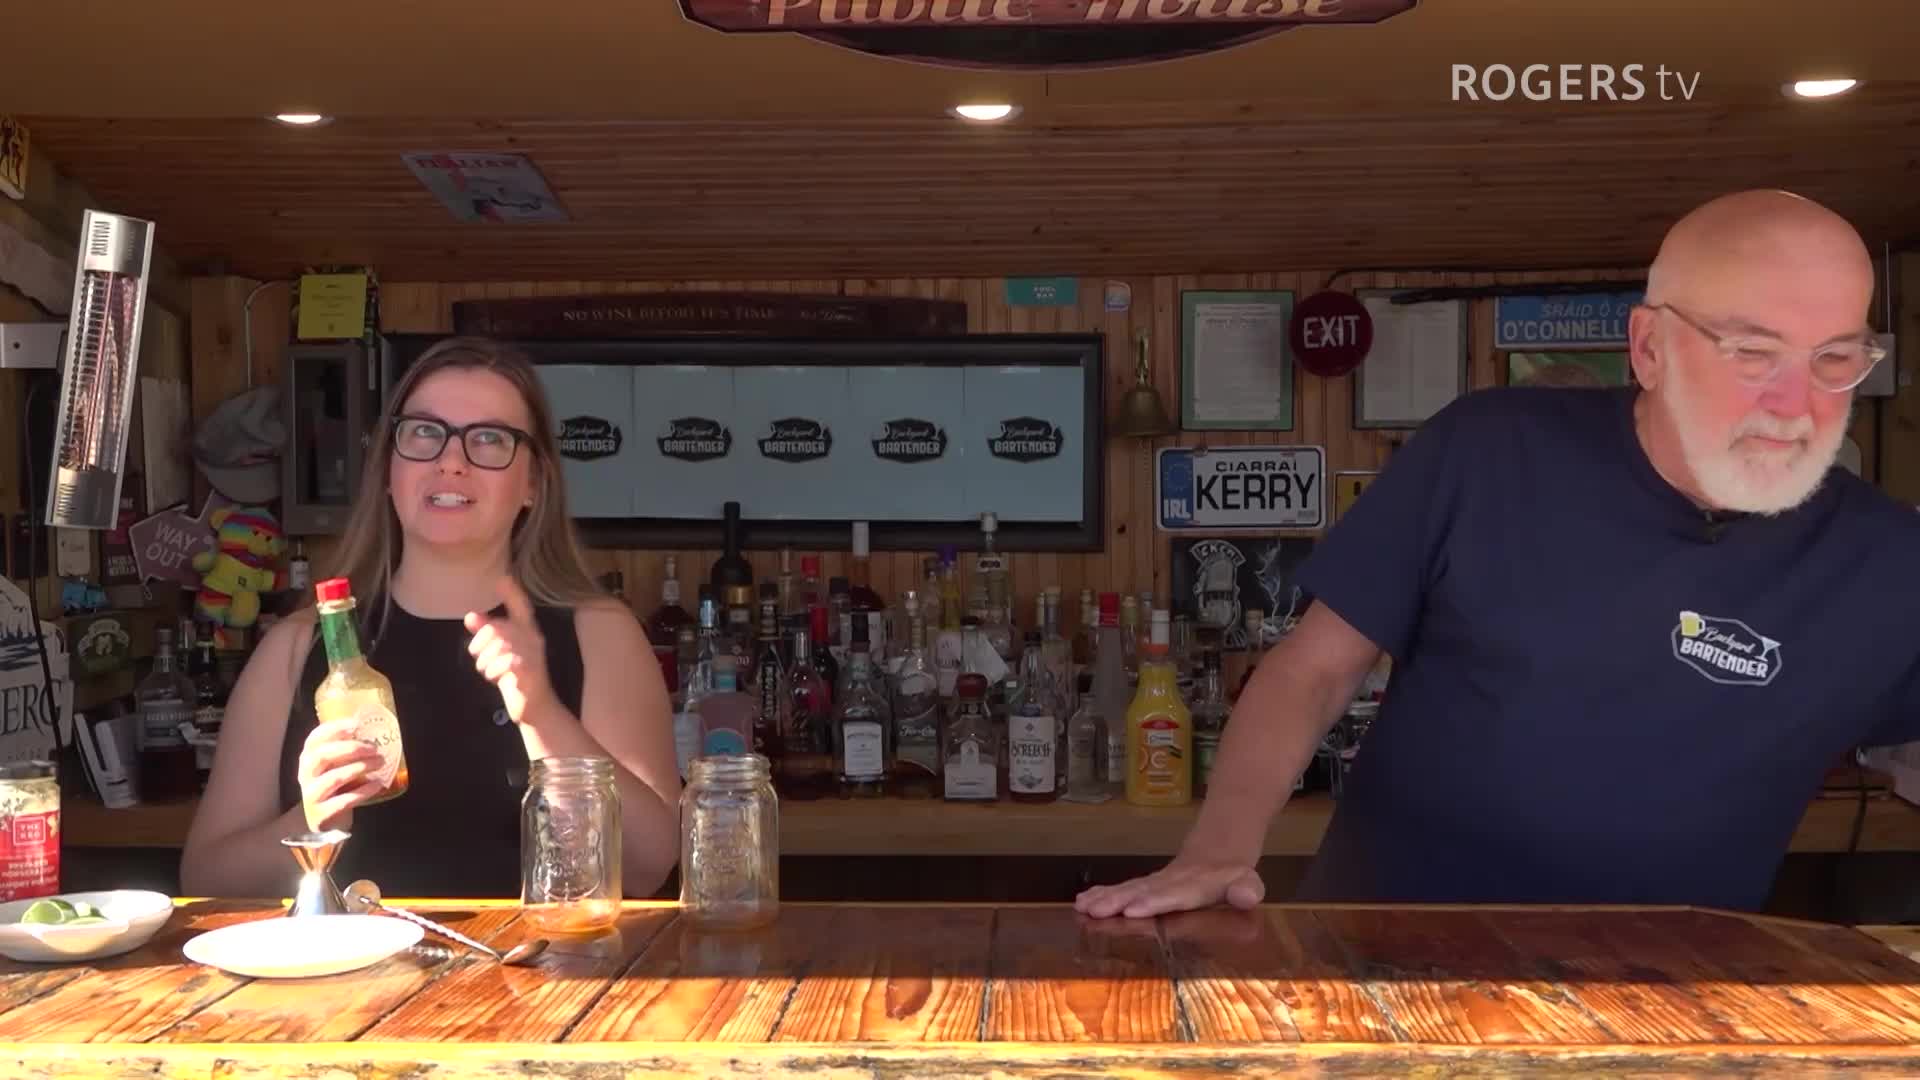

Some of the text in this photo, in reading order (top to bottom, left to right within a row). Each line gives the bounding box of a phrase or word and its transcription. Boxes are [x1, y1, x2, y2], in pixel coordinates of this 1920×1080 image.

[1303, 314, 1361, 350] EXIT
[1503, 319, 1626, 341] O'CONNELL
[1163, 473, 1315, 519] IRL KERRY
[154, 519, 197, 552] WAY
[145, 542, 189, 570] OUT
[1679, 637, 1769, 679] BARTENDER
[1011, 742, 1051, 758] SCREECH
